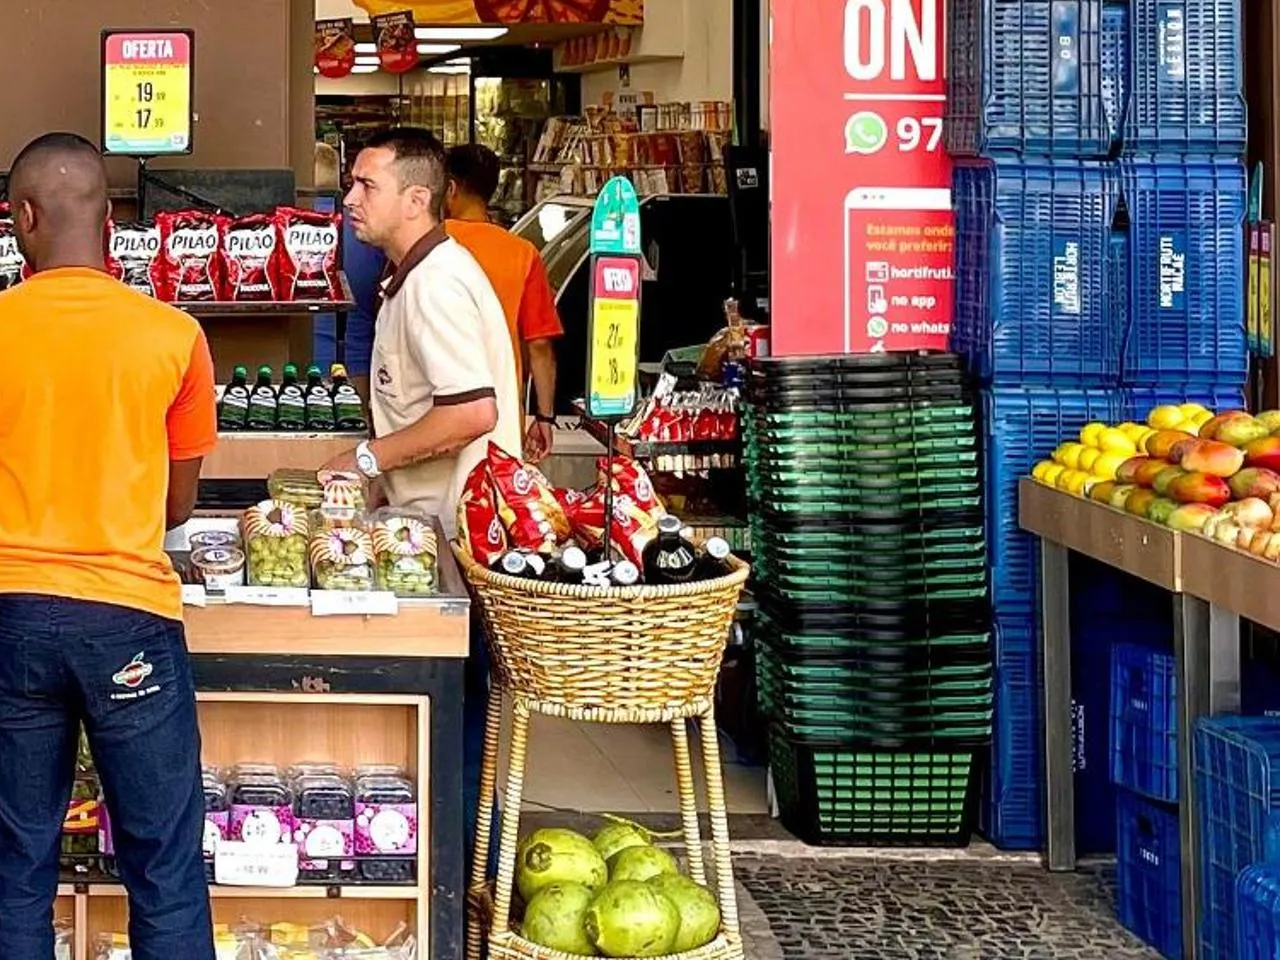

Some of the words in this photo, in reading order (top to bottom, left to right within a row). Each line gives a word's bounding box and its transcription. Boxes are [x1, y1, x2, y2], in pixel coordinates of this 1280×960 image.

[122, 39, 174, 59] OFERTA
[288, 228, 335, 247] PILÃO
[866, 224, 921, 237] Estamos
[113, 231, 159, 252] PILÃO
[171, 231, 216, 251] PILÃO
[228, 232, 273, 253] PILÃO
[866, 240, 896, 252] você
[1160, 237, 1173, 308] HORTIFRUTI
[891, 296, 909, 307] no
[910, 296, 936, 309] app
[891, 322, 909, 333] no
[911, 321, 956, 334] whats
